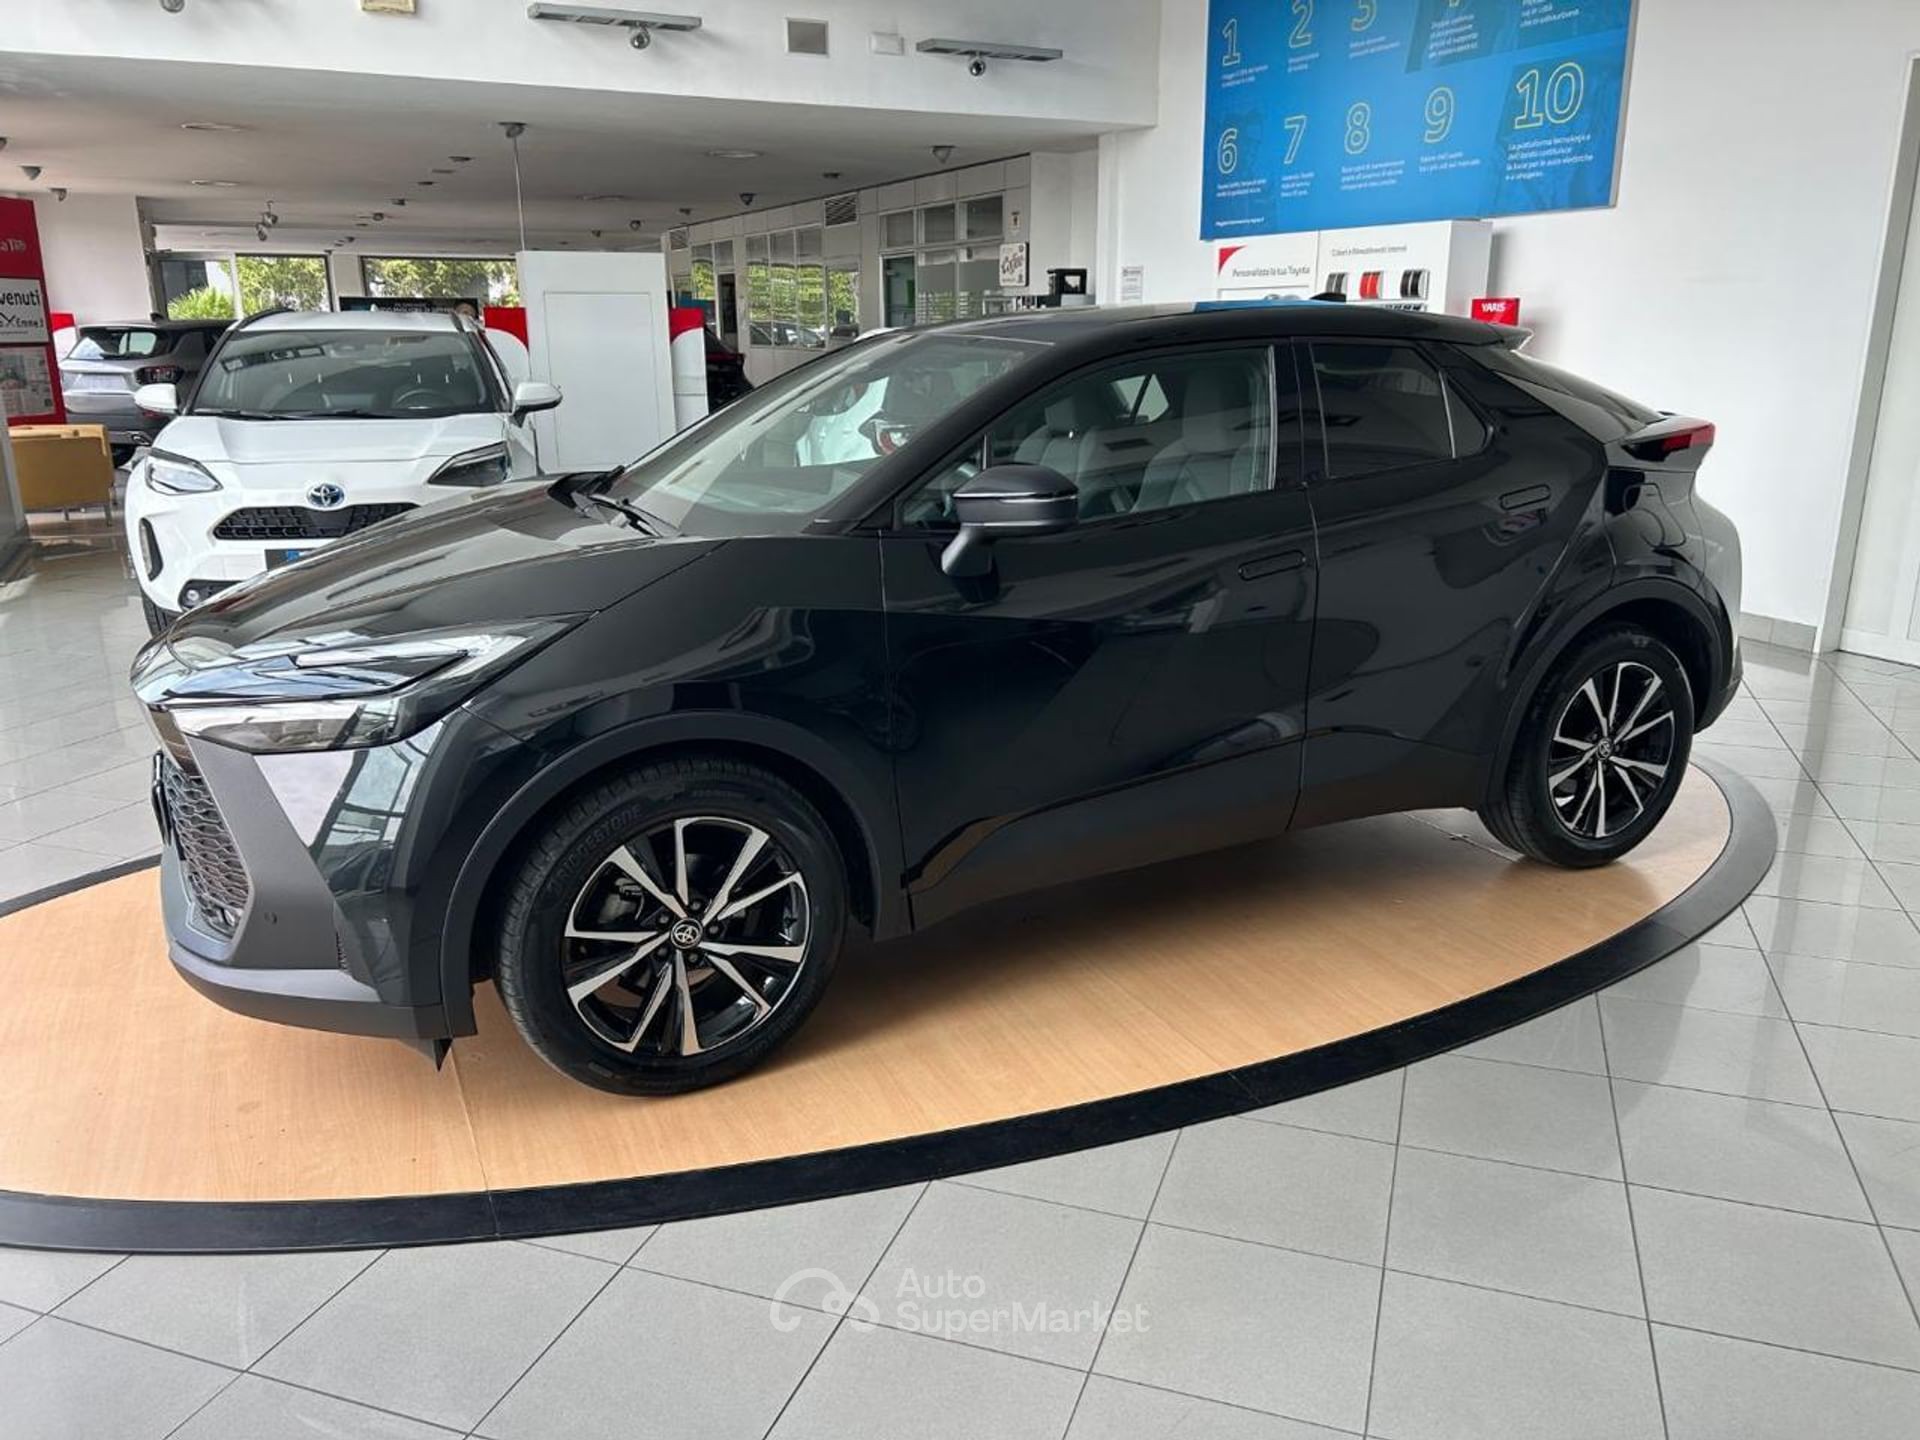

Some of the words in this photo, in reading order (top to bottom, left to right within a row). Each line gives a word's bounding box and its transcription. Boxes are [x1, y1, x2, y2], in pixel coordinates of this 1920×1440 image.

[1222, 18, 1240, 67] 1
[1289, 0, 1313, 48] 2
[1423, 86, 1454, 143] 9
[1513, 61, 1584, 130] 10
[1217, 127, 1238, 174] 6
[1283, 115, 1307, 165] 7
[1344, 101, 1371, 155] 8
